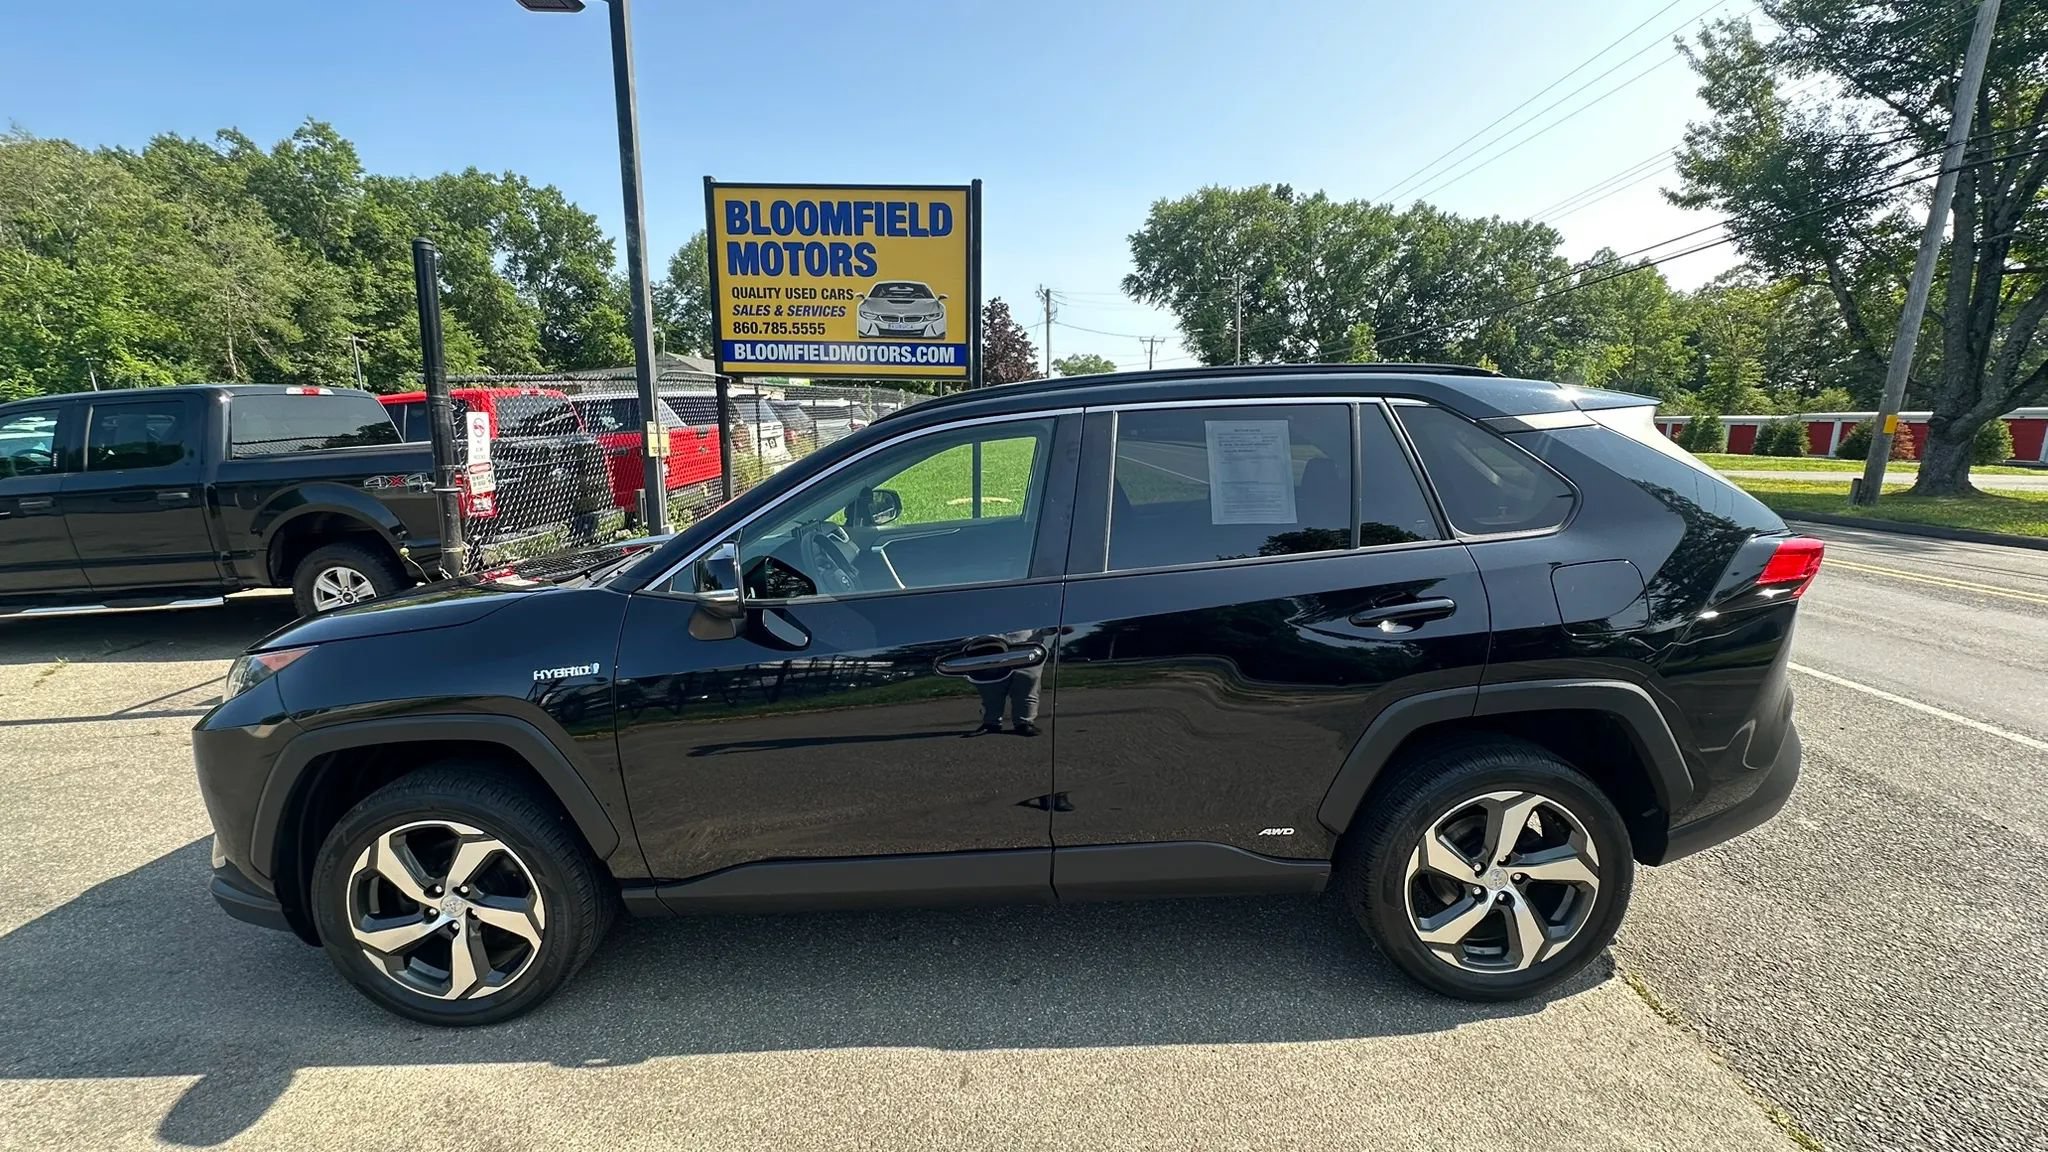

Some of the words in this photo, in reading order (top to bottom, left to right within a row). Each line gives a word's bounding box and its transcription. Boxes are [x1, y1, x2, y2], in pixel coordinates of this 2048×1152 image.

[725, 200, 953, 237] BLOOMFIELD
[726, 241, 878, 277] MOTORS
[732, 287, 781, 299] QUALITY
[785, 288, 817, 300] USED
[821, 288, 854, 300] CARS
[732, 304, 771, 317] SALES
[774, 304, 783, 317] &
[787, 305, 846, 318] SERVICES
[733, 321, 826, 335] 860.785.5555
[734, 343, 955, 363] BLOOMFIELDMOTORS.COM
[533, 665, 591, 680] HYBRID
[1259, 827, 1295, 836] AWD
